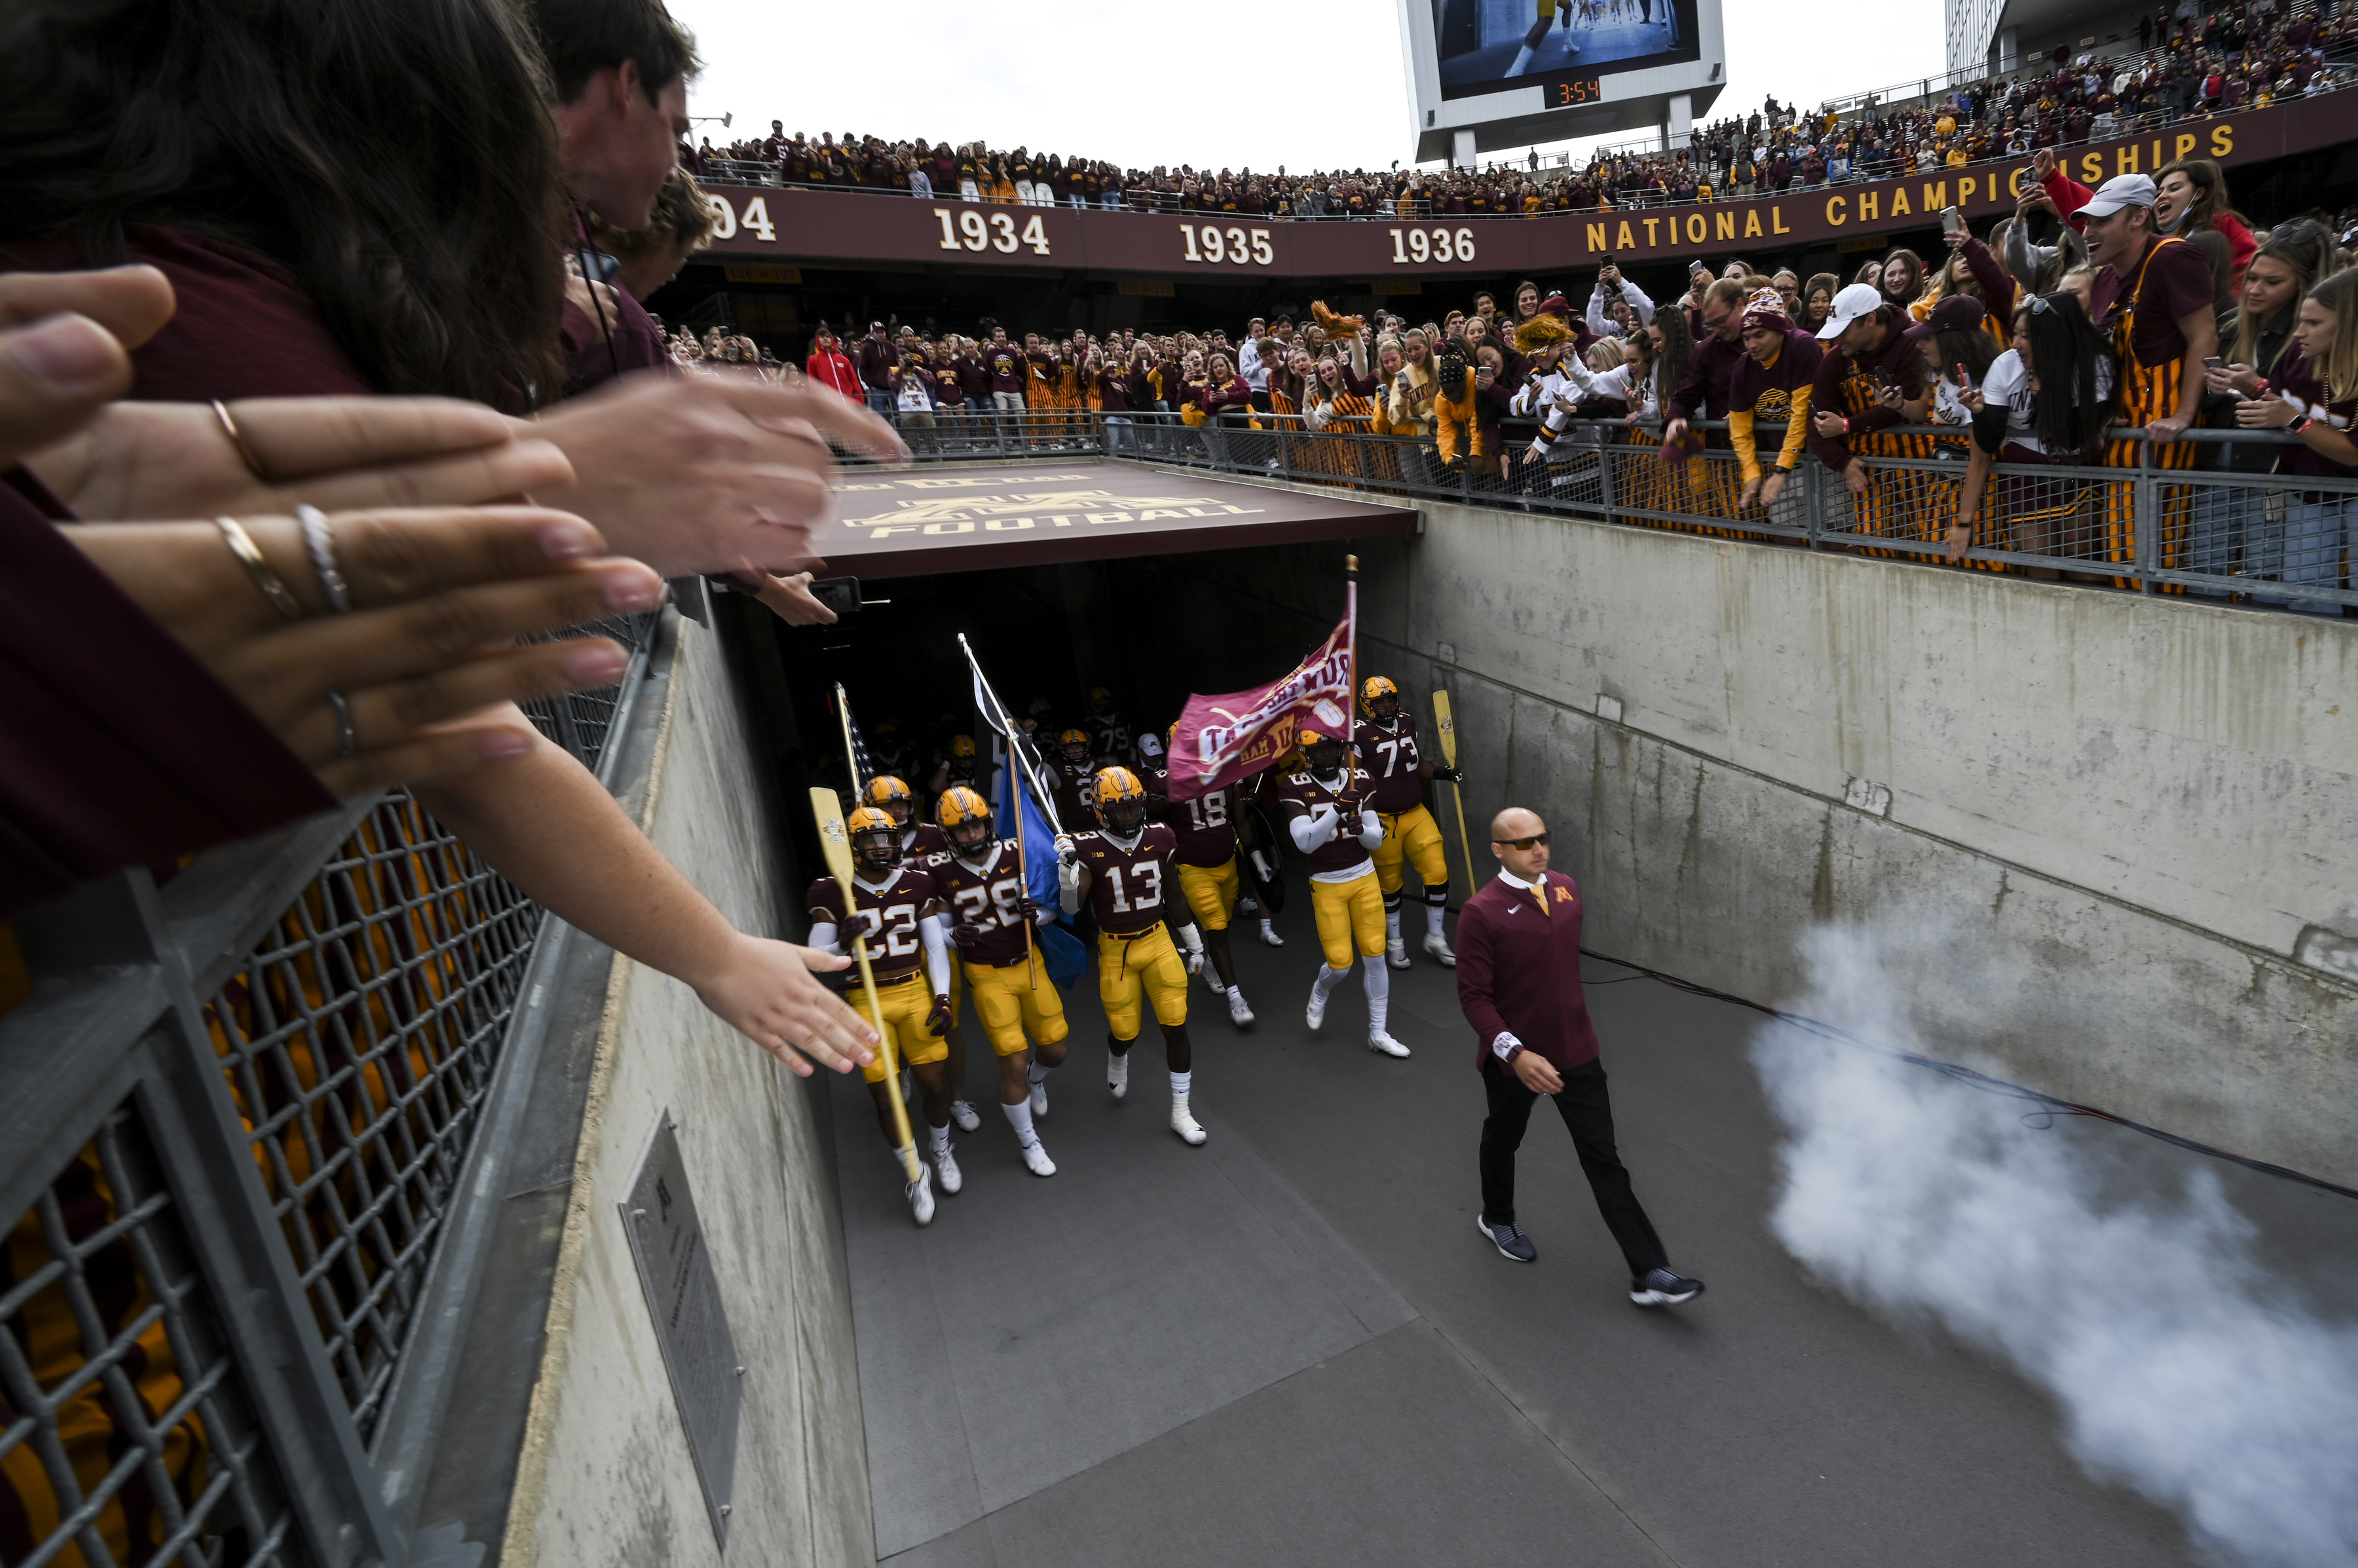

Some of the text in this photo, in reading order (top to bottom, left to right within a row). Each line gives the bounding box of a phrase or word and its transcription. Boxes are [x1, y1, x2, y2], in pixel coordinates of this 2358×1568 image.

[1560, 81, 1599, 103] 3:54
[933, 208, 1051, 255] 1934
[1180, 223, 1274, 265] 1935
[1389, 228, 1476, 264] 1936
[1586, 205, 1790, 252] NATIONAL
[729, 267, 754, 280] 126
[869, 504, 1265, 538] FOOTBALL
[1100, 727, 1128, 753] 79
[1376, 736, 1419, 779] 73
[1184, 789, 1227, 831] 18
[952, 876, 1024, 933] 28
[1104, 859, 1162, 914] 13
[852, 903, 919, 961] 22
